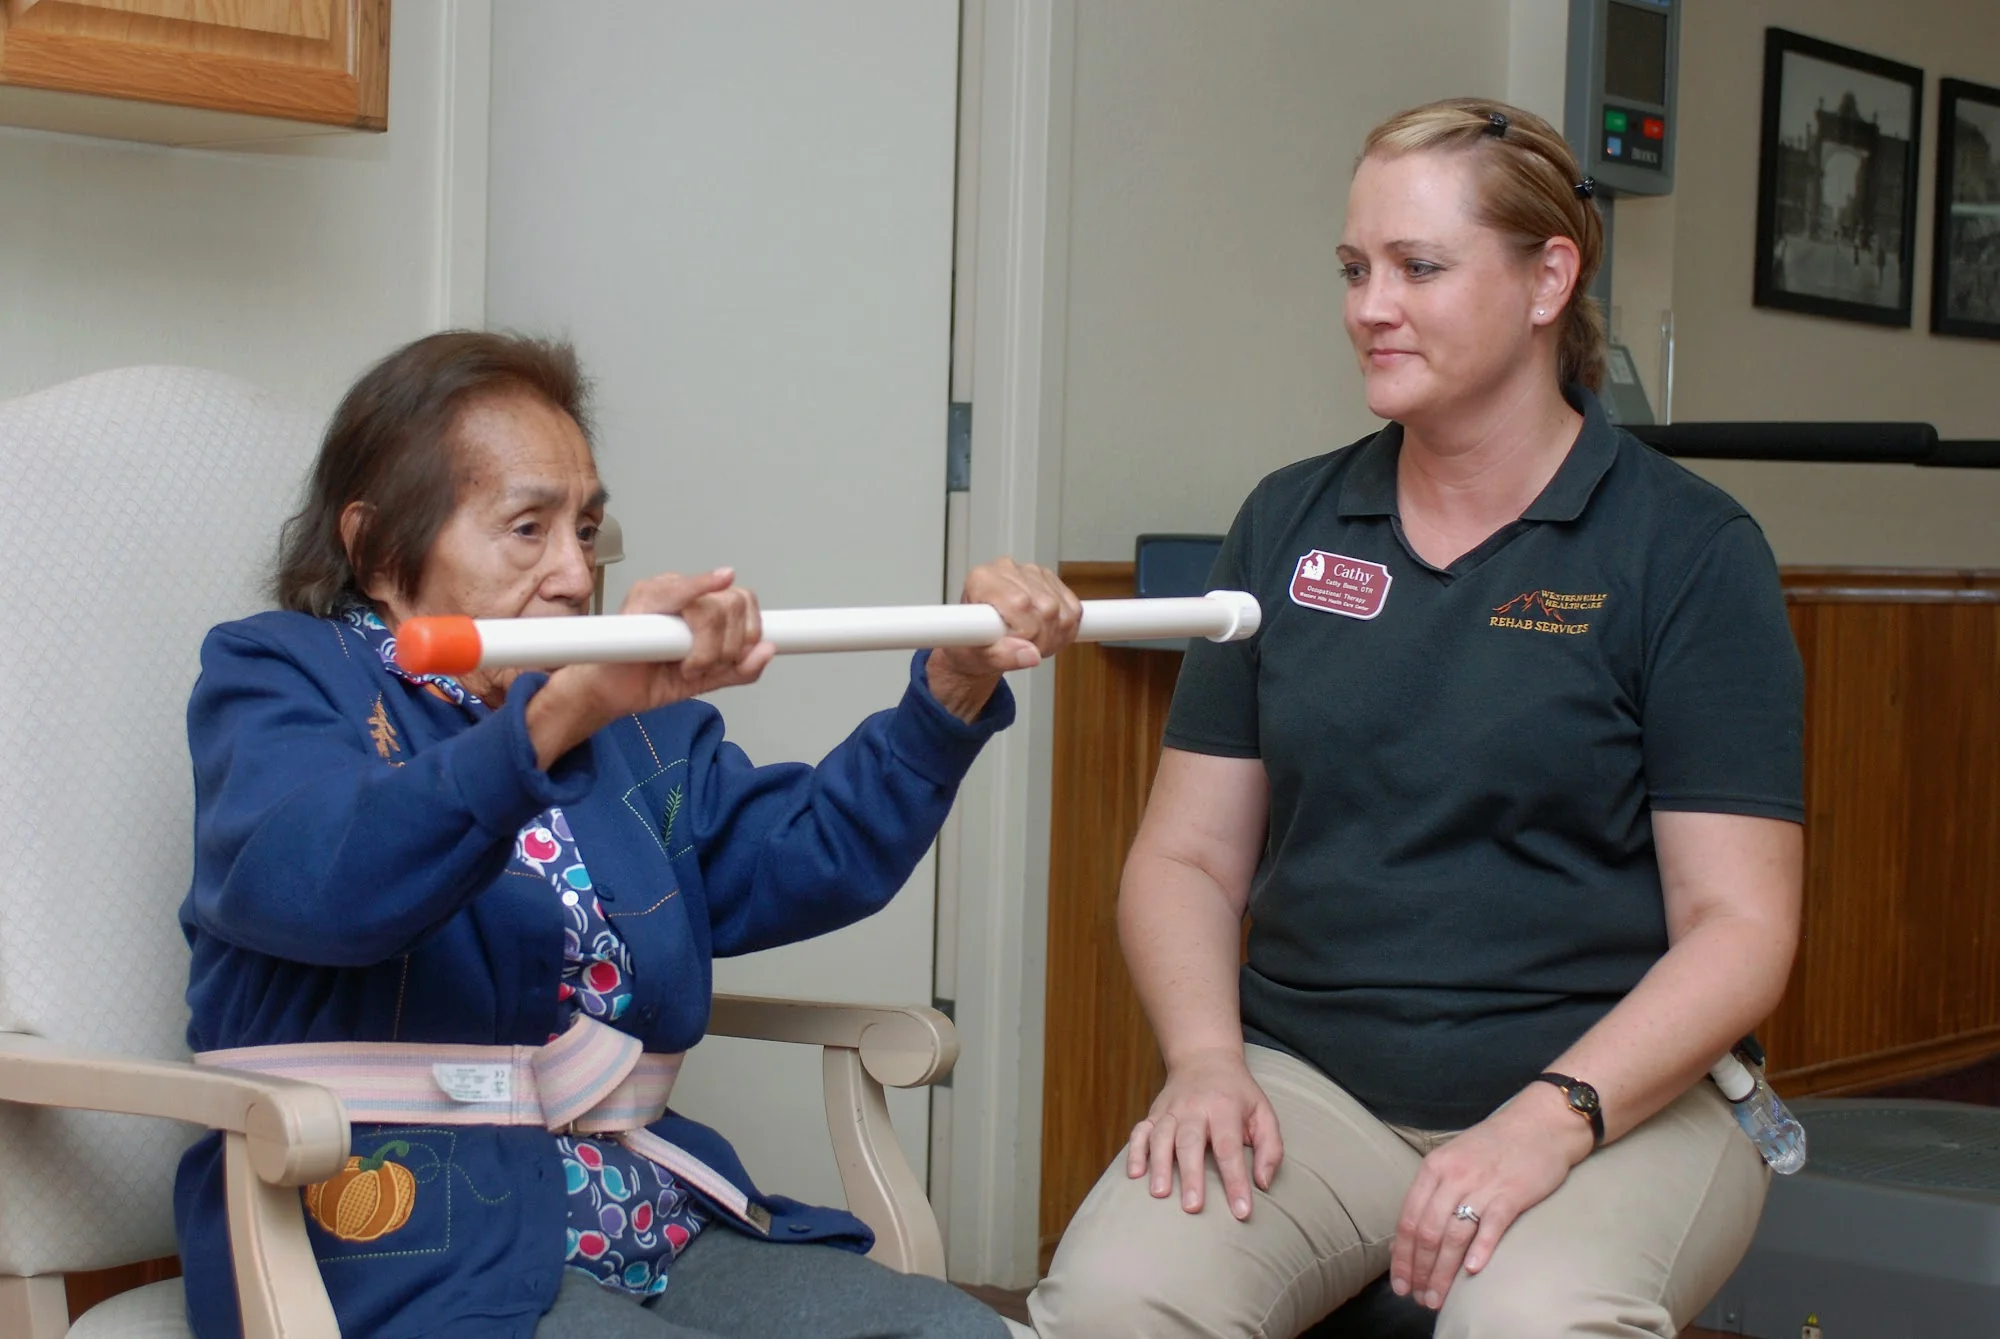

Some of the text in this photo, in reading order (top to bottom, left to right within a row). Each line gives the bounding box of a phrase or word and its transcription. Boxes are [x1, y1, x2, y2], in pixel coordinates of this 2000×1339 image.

[1326, 579, 1341, 588] Cathy
[1334, 563, 1374, 585] Cathy
[1307, 585, 1366, 604] Occupational Therapy
[1489, 616, 1589, 635] REHAB SERVICES
